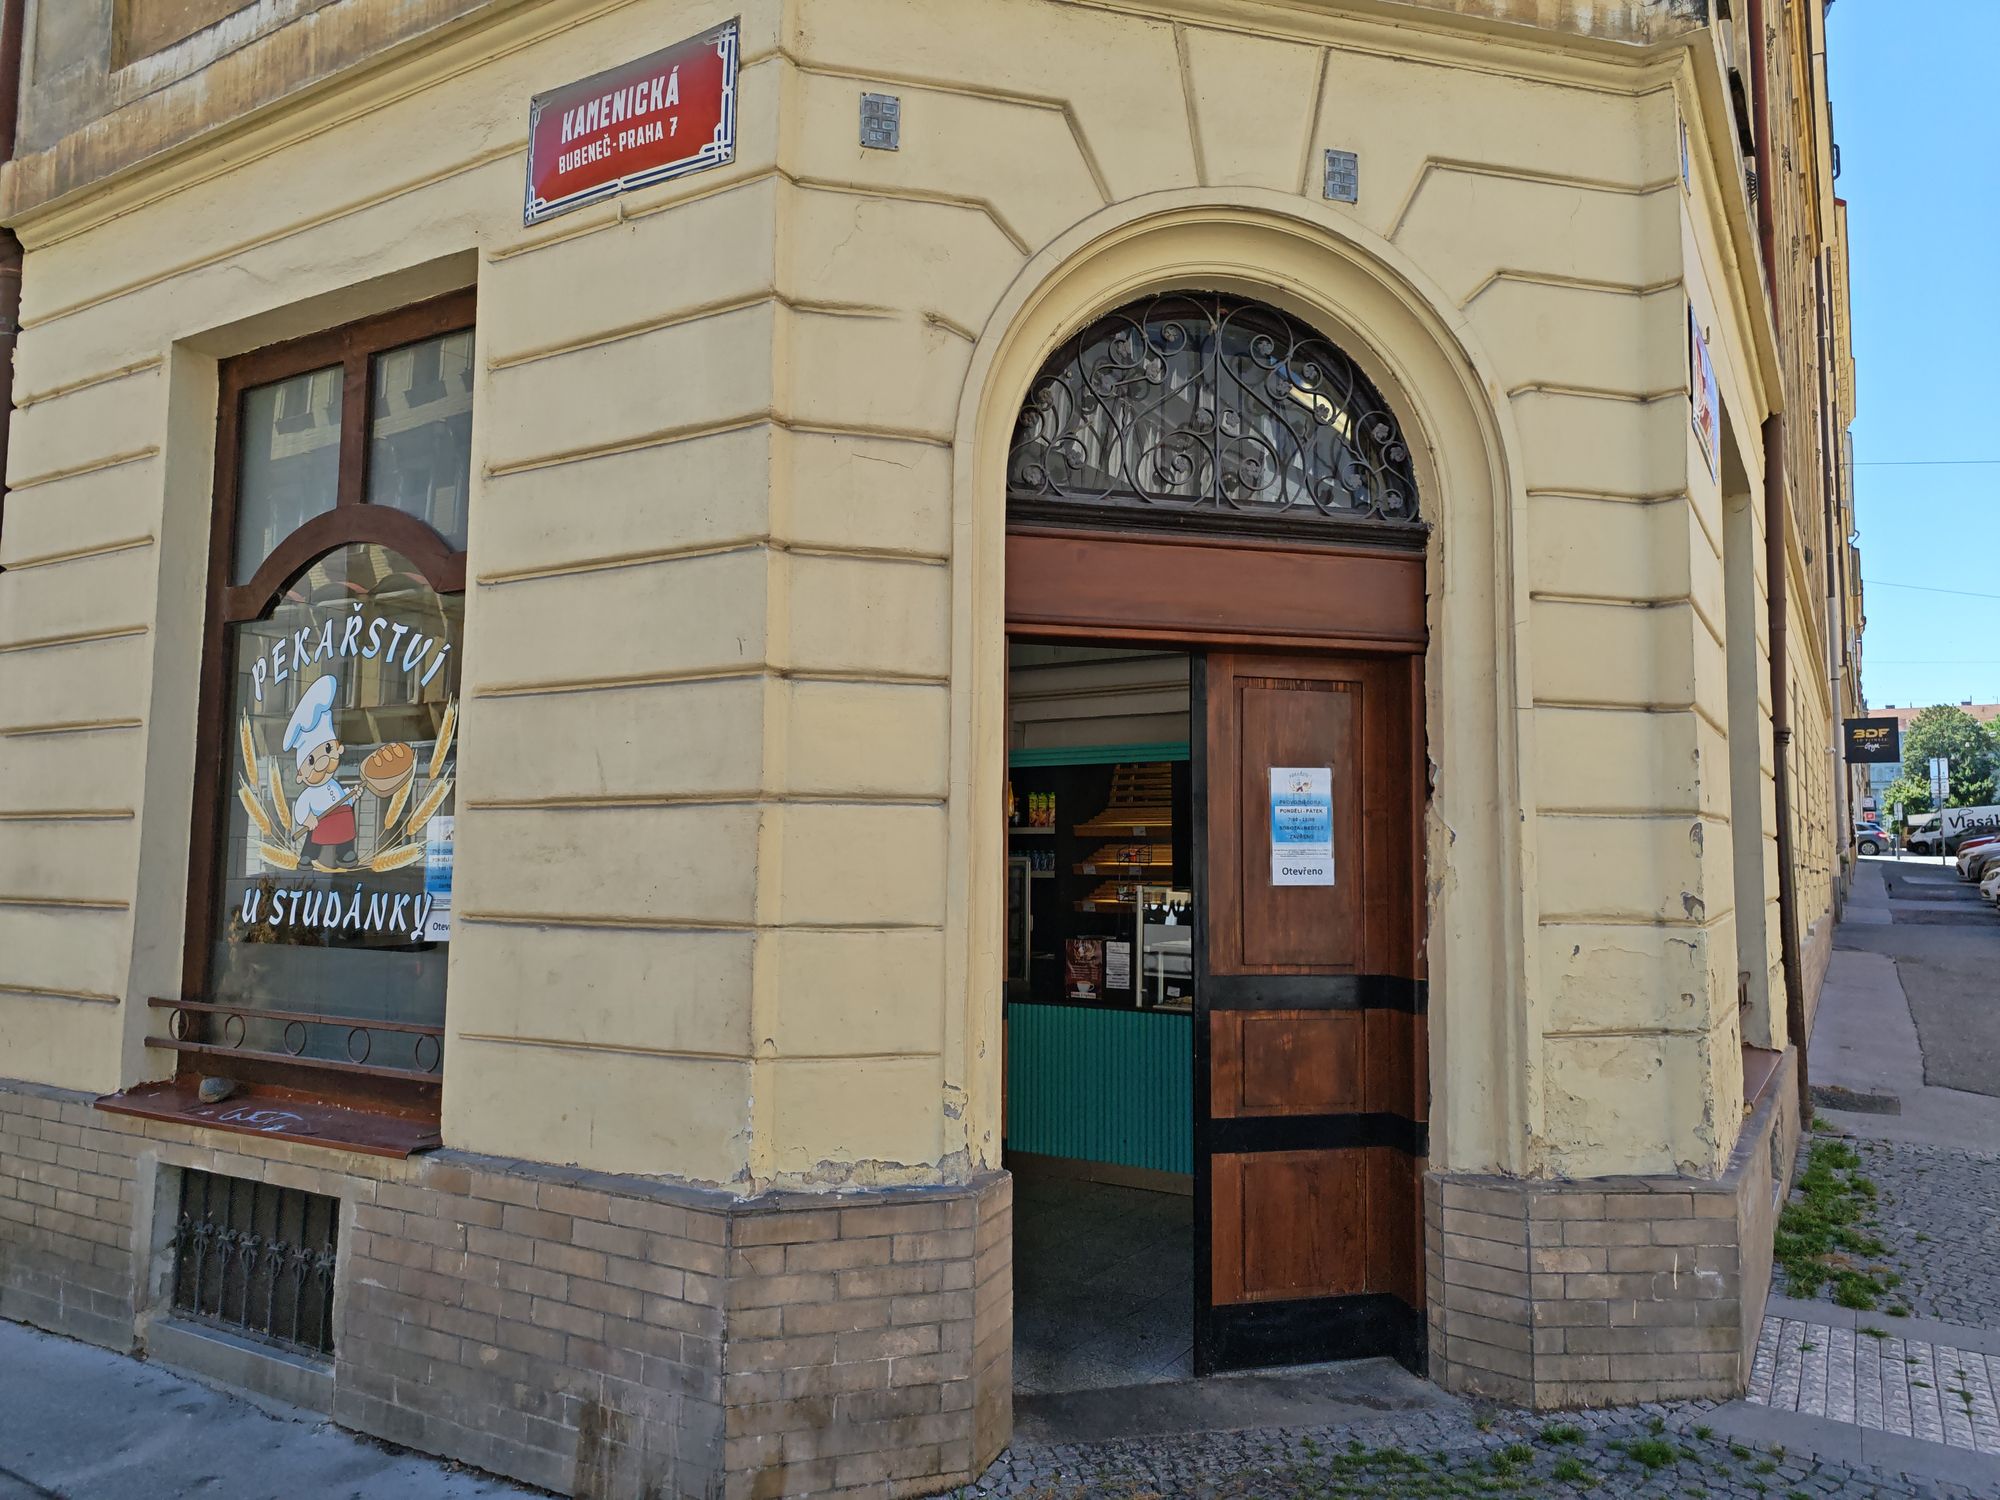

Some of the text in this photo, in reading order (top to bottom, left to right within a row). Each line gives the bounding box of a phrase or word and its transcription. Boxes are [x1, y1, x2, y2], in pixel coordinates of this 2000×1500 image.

[561, 65, 679, 144] KAMENICKÁ
[669, 117, 679, 137] 7
[251, 602, 451, 702] PEKAŘSTVÍ
[1853, 728, 1890, 739] 3DF
[1281, 866, 1323, 876] Otevřeno
[241, 882, 434, 942] U STUDÁNKY
